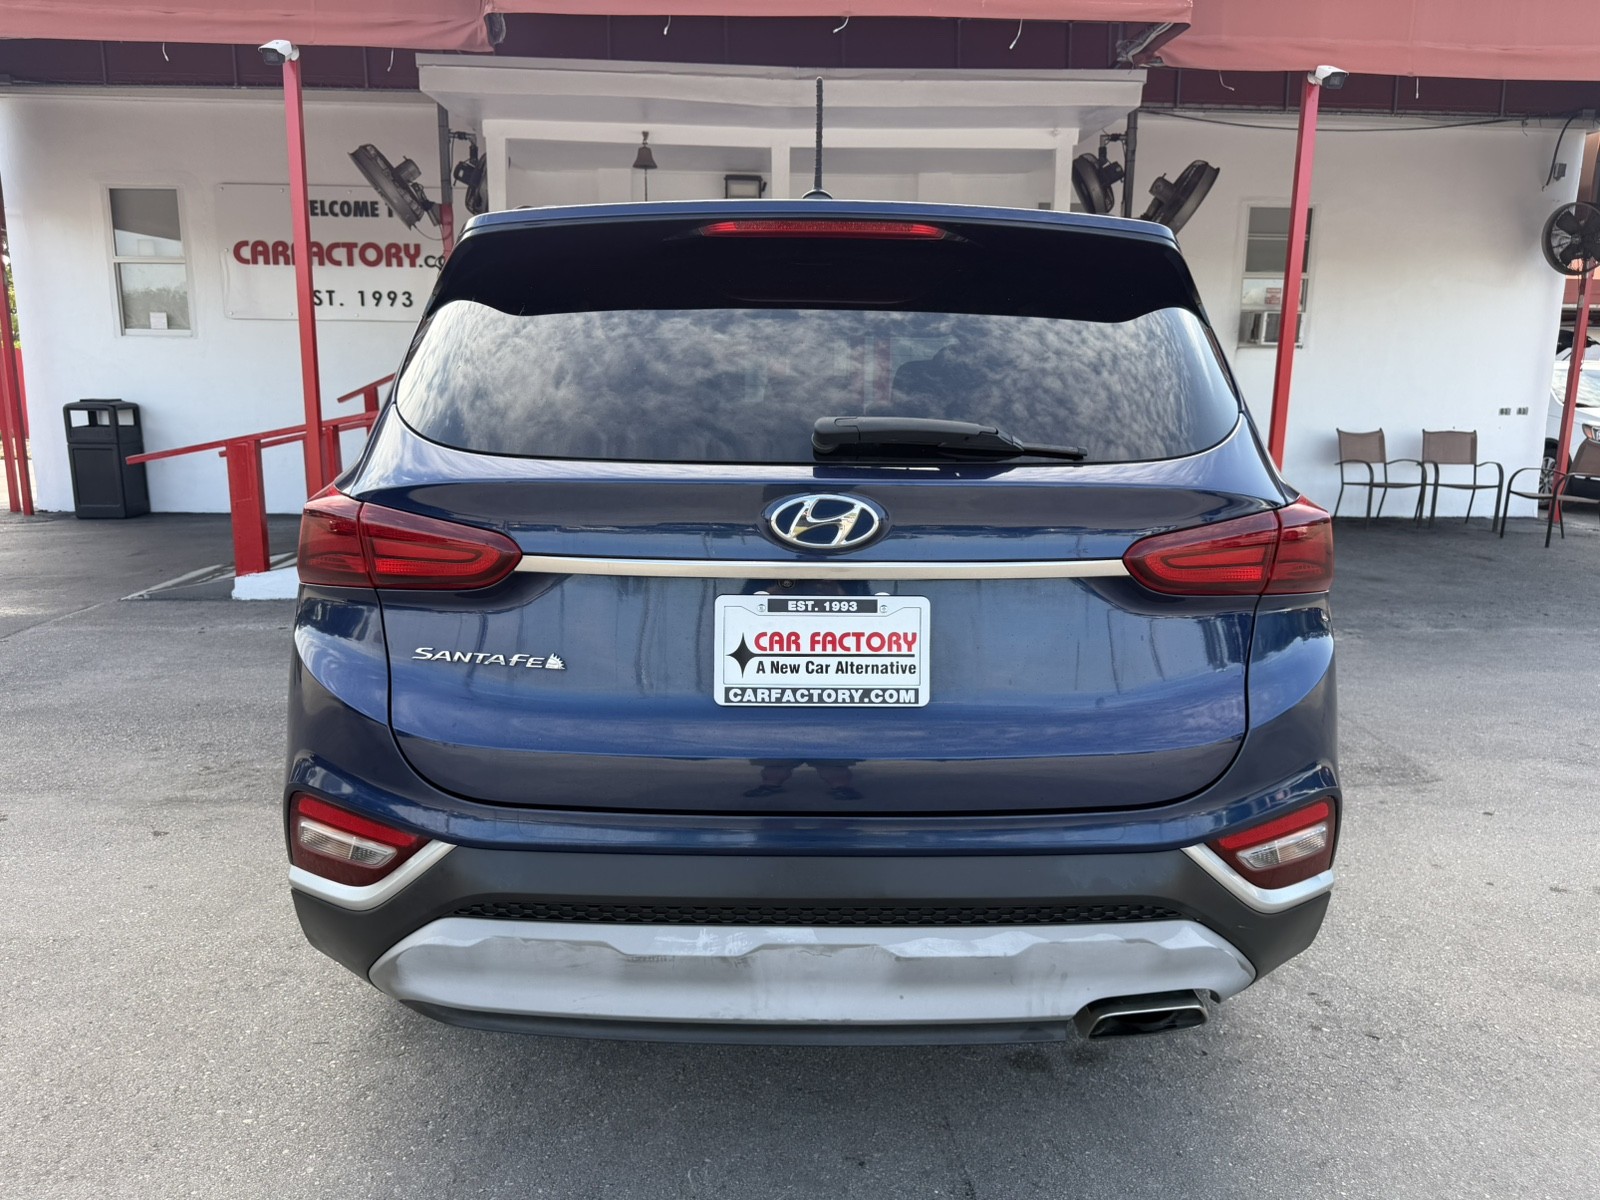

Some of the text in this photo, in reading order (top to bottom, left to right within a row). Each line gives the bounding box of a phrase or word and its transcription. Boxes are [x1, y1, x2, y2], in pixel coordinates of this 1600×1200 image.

[309, 199, 394, 218] ELCOME T
[312, 289, 414, 308] ST. 1993
[787, 600, 858, 612] EST. 1993
[754, 631, 918, 652] CAR FACTORY
[756, 660, 917, 675] A New Car Alternative
[728, 688, 916, 704] CARFACTORY.COM
